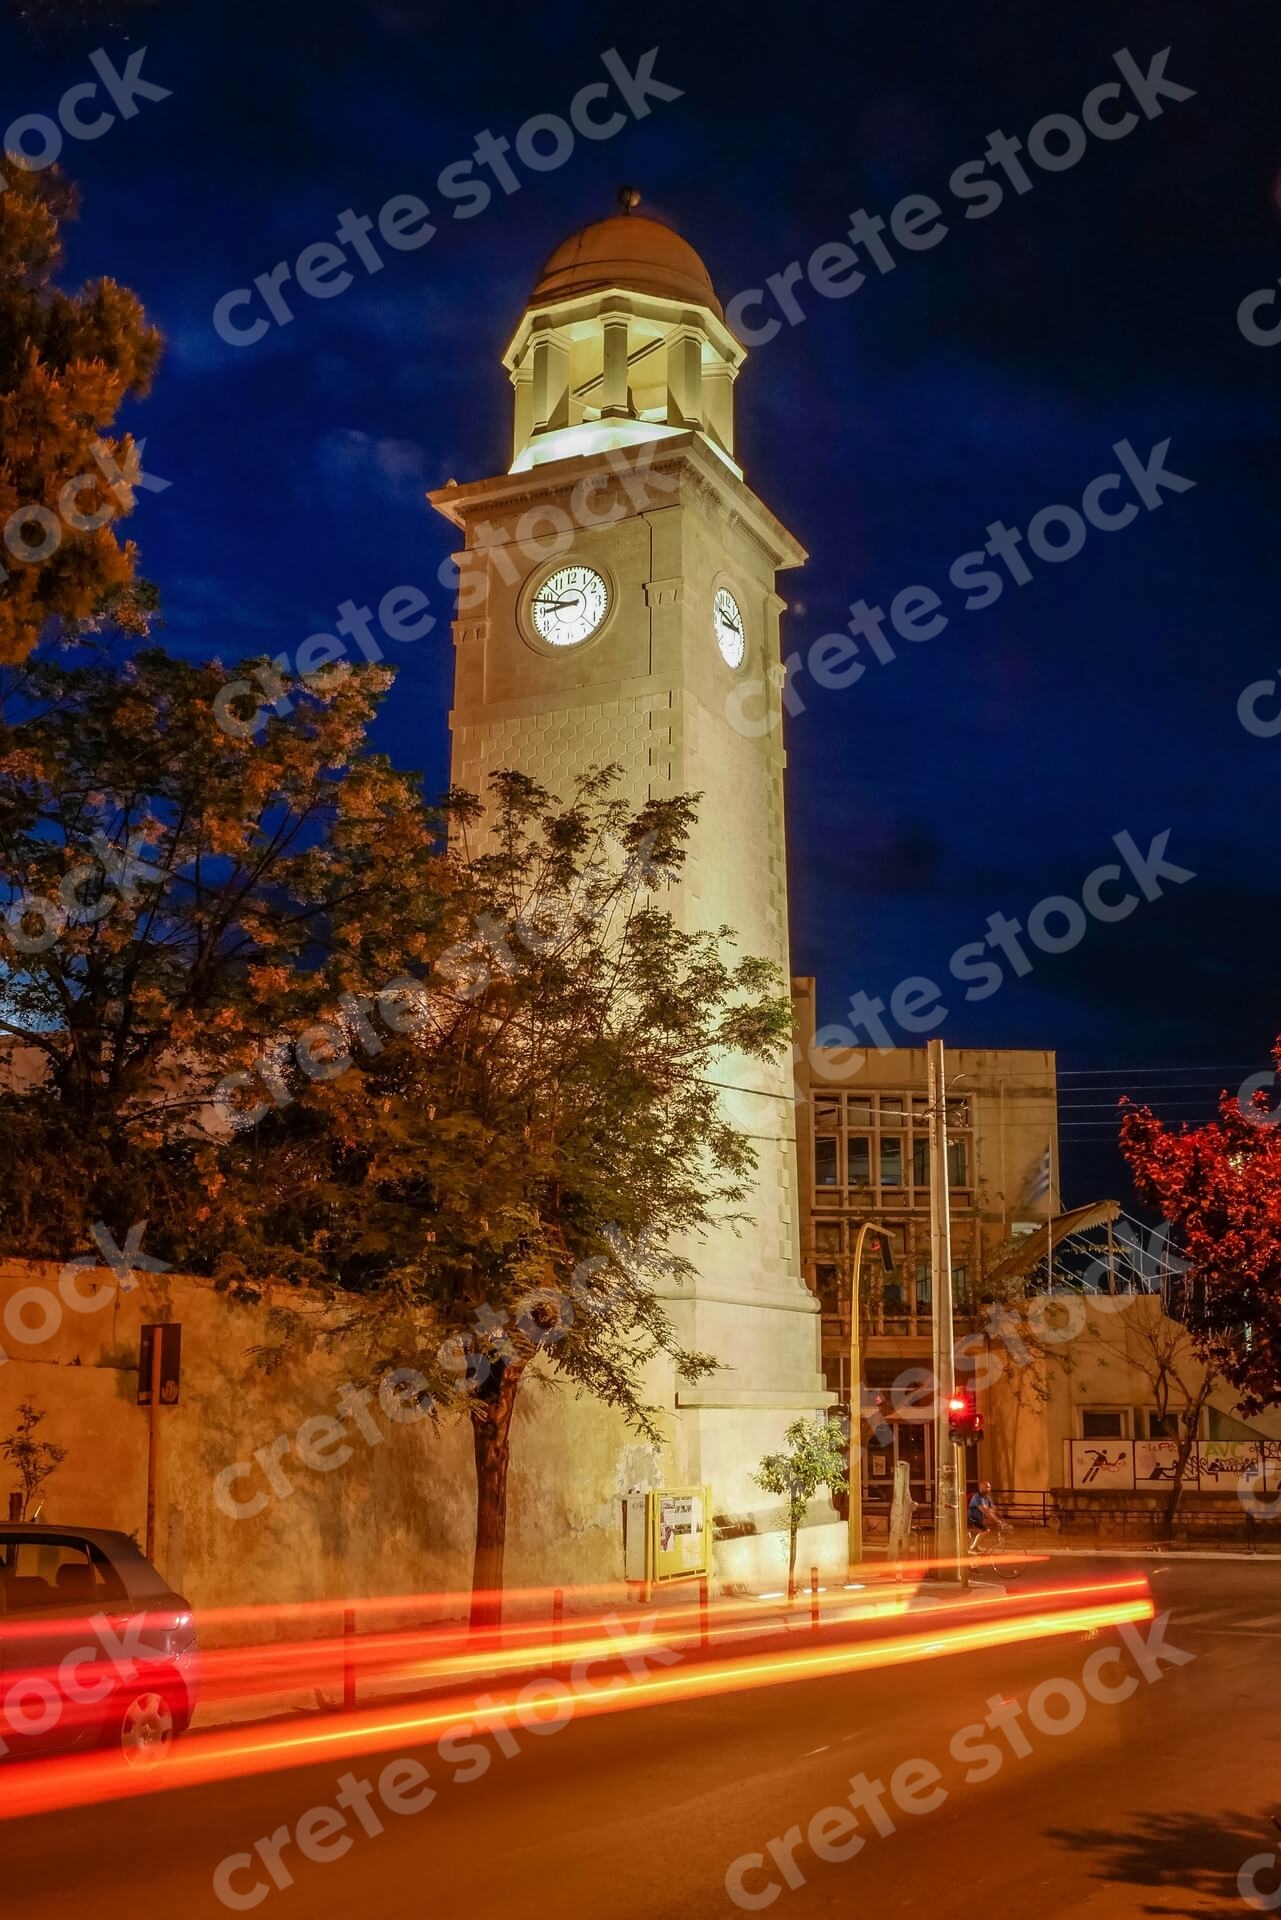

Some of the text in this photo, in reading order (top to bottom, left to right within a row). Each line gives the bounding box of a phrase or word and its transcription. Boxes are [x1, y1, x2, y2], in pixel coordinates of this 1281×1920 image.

[556, 578, 562, 590] 11
[568, 572, 577, 584] 12
[590, 582, 597, 594] 2
[595, 594, 602, 606] 3
[540, 606, 546, 619] 9
[544, 620, 550, 632] 8
